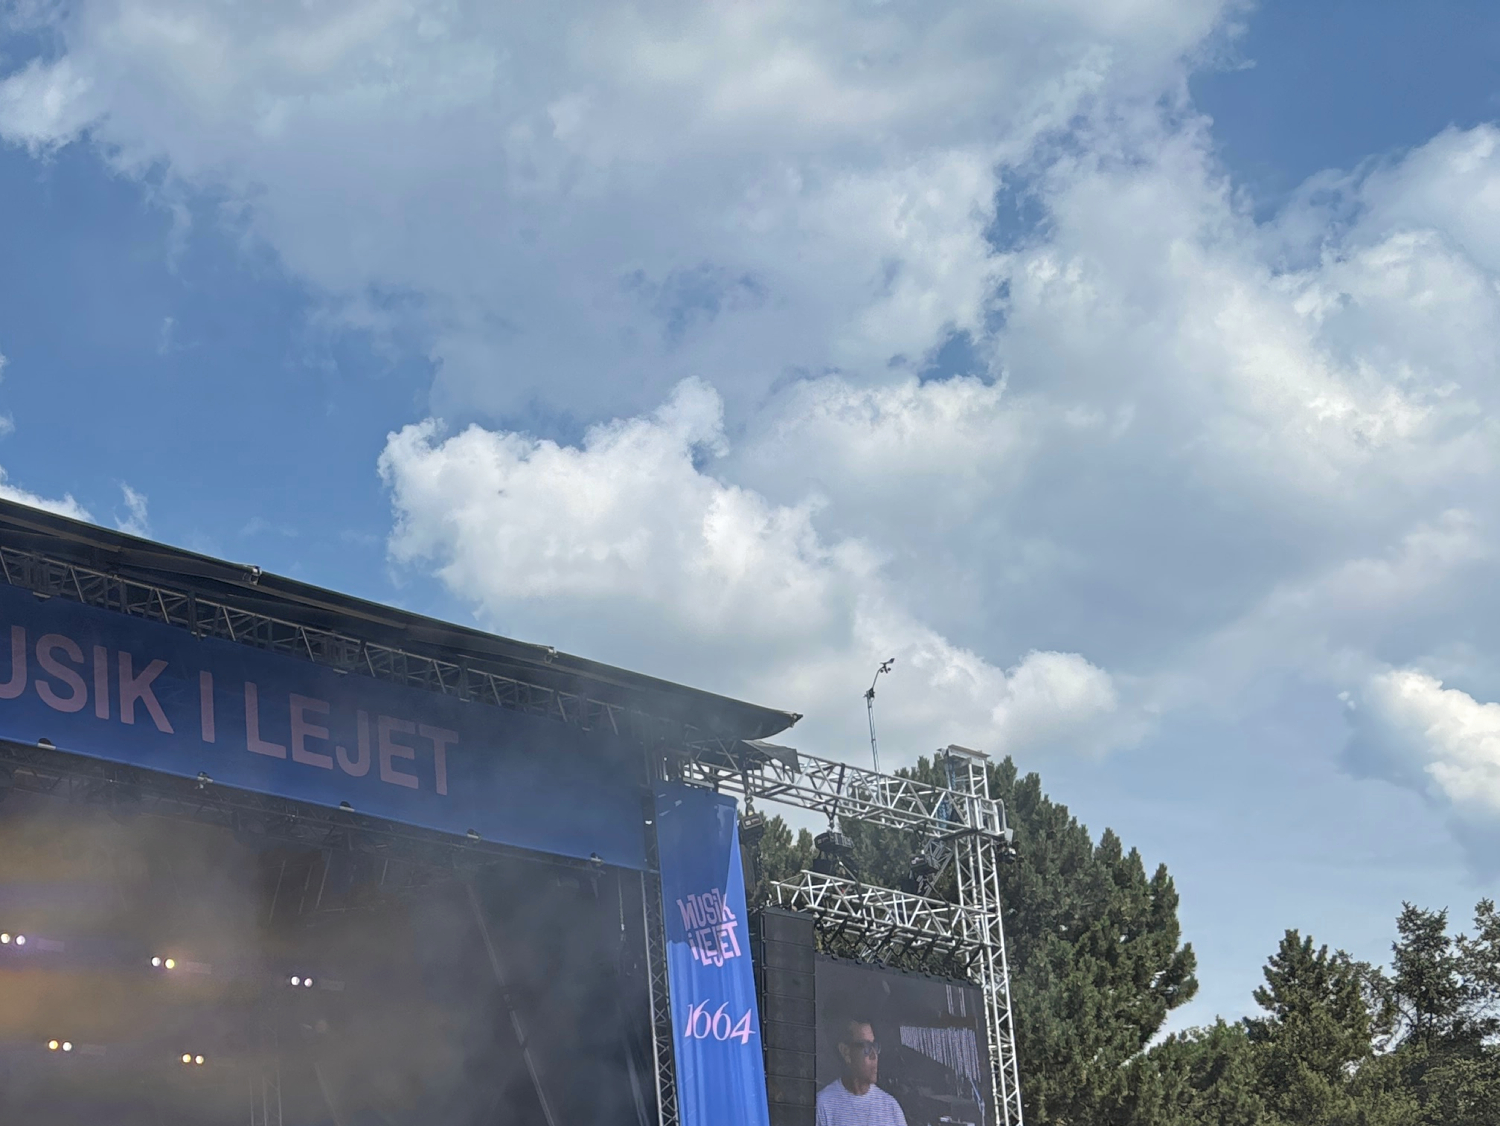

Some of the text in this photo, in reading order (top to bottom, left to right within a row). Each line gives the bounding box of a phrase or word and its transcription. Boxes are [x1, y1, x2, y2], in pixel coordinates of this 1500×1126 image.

[200, 670, 216, 744] I
[244, 681, 460, 796] LEJET
[695, 920, 742, 968] LEJET
[684, 998, 757, 1045] 1664
